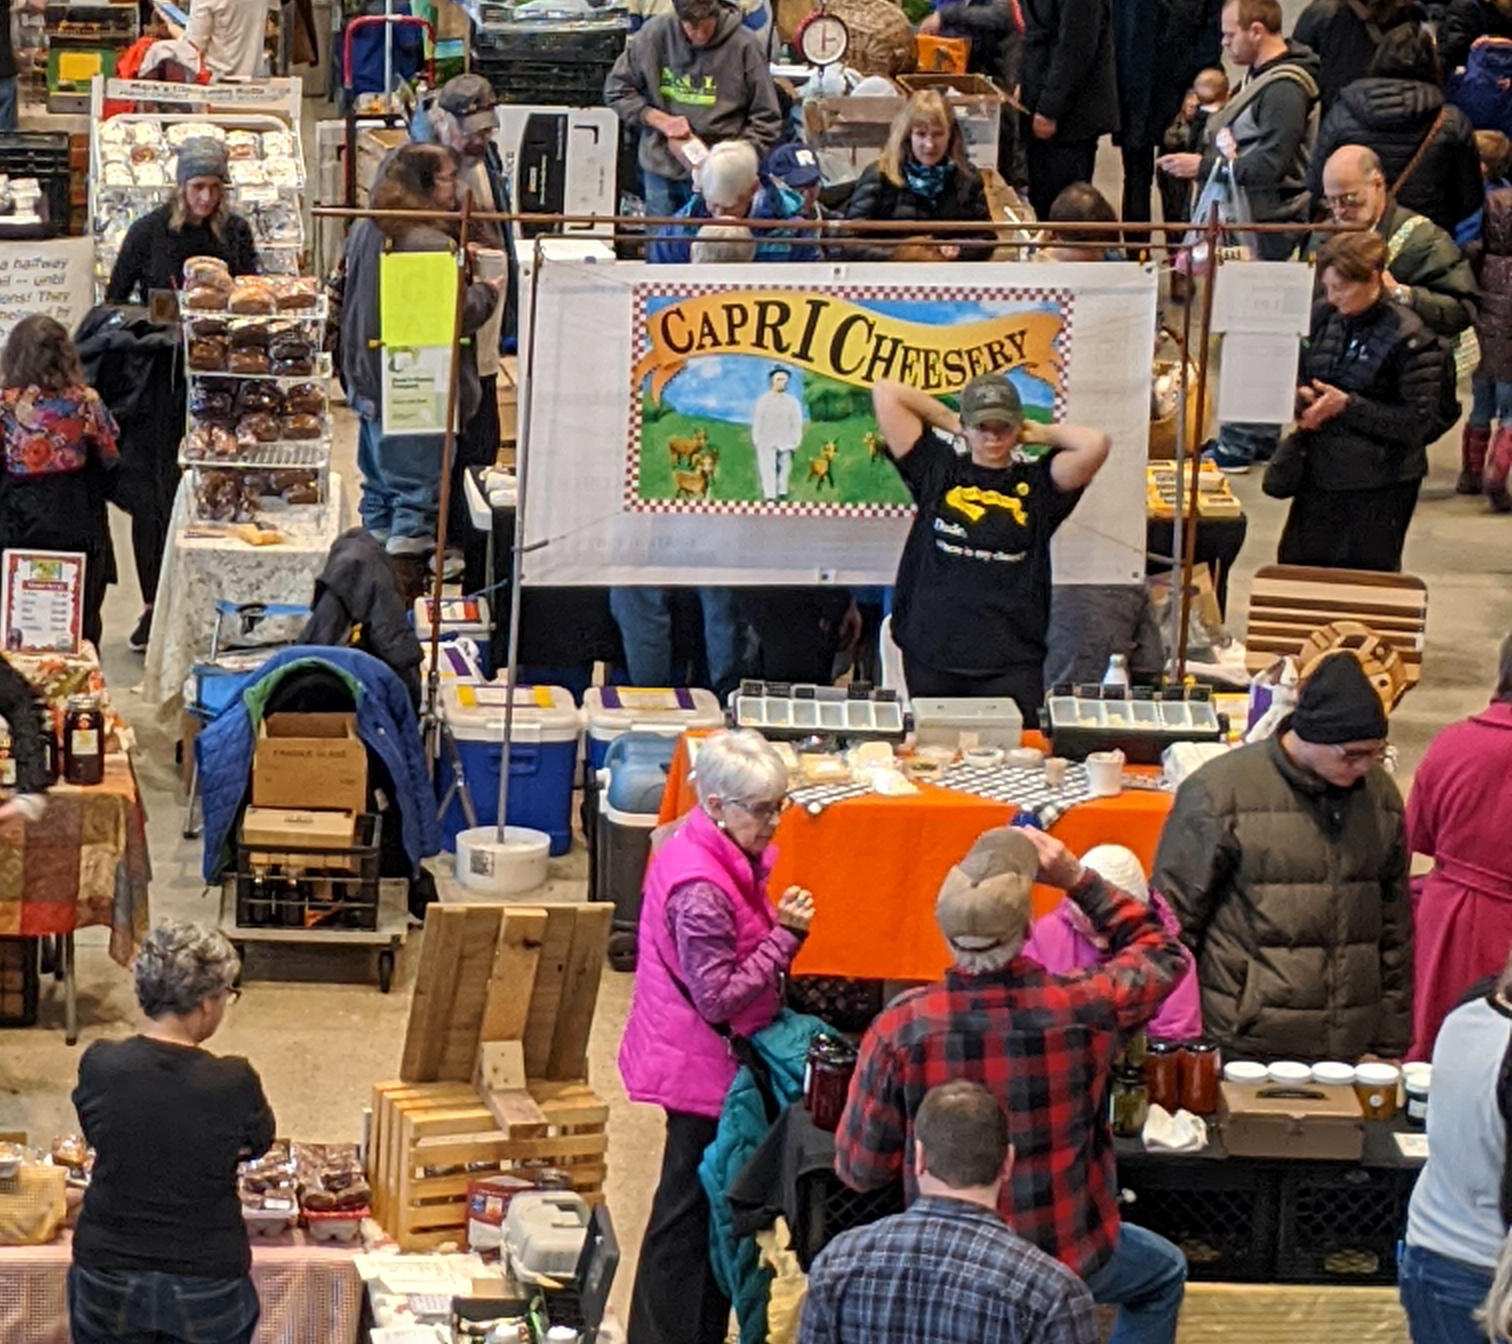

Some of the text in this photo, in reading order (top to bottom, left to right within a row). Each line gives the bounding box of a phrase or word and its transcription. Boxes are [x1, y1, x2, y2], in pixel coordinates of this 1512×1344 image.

[0, 261, 9, 271] a
[660, 299, 1029, 390] CAPRI CHEESERY
